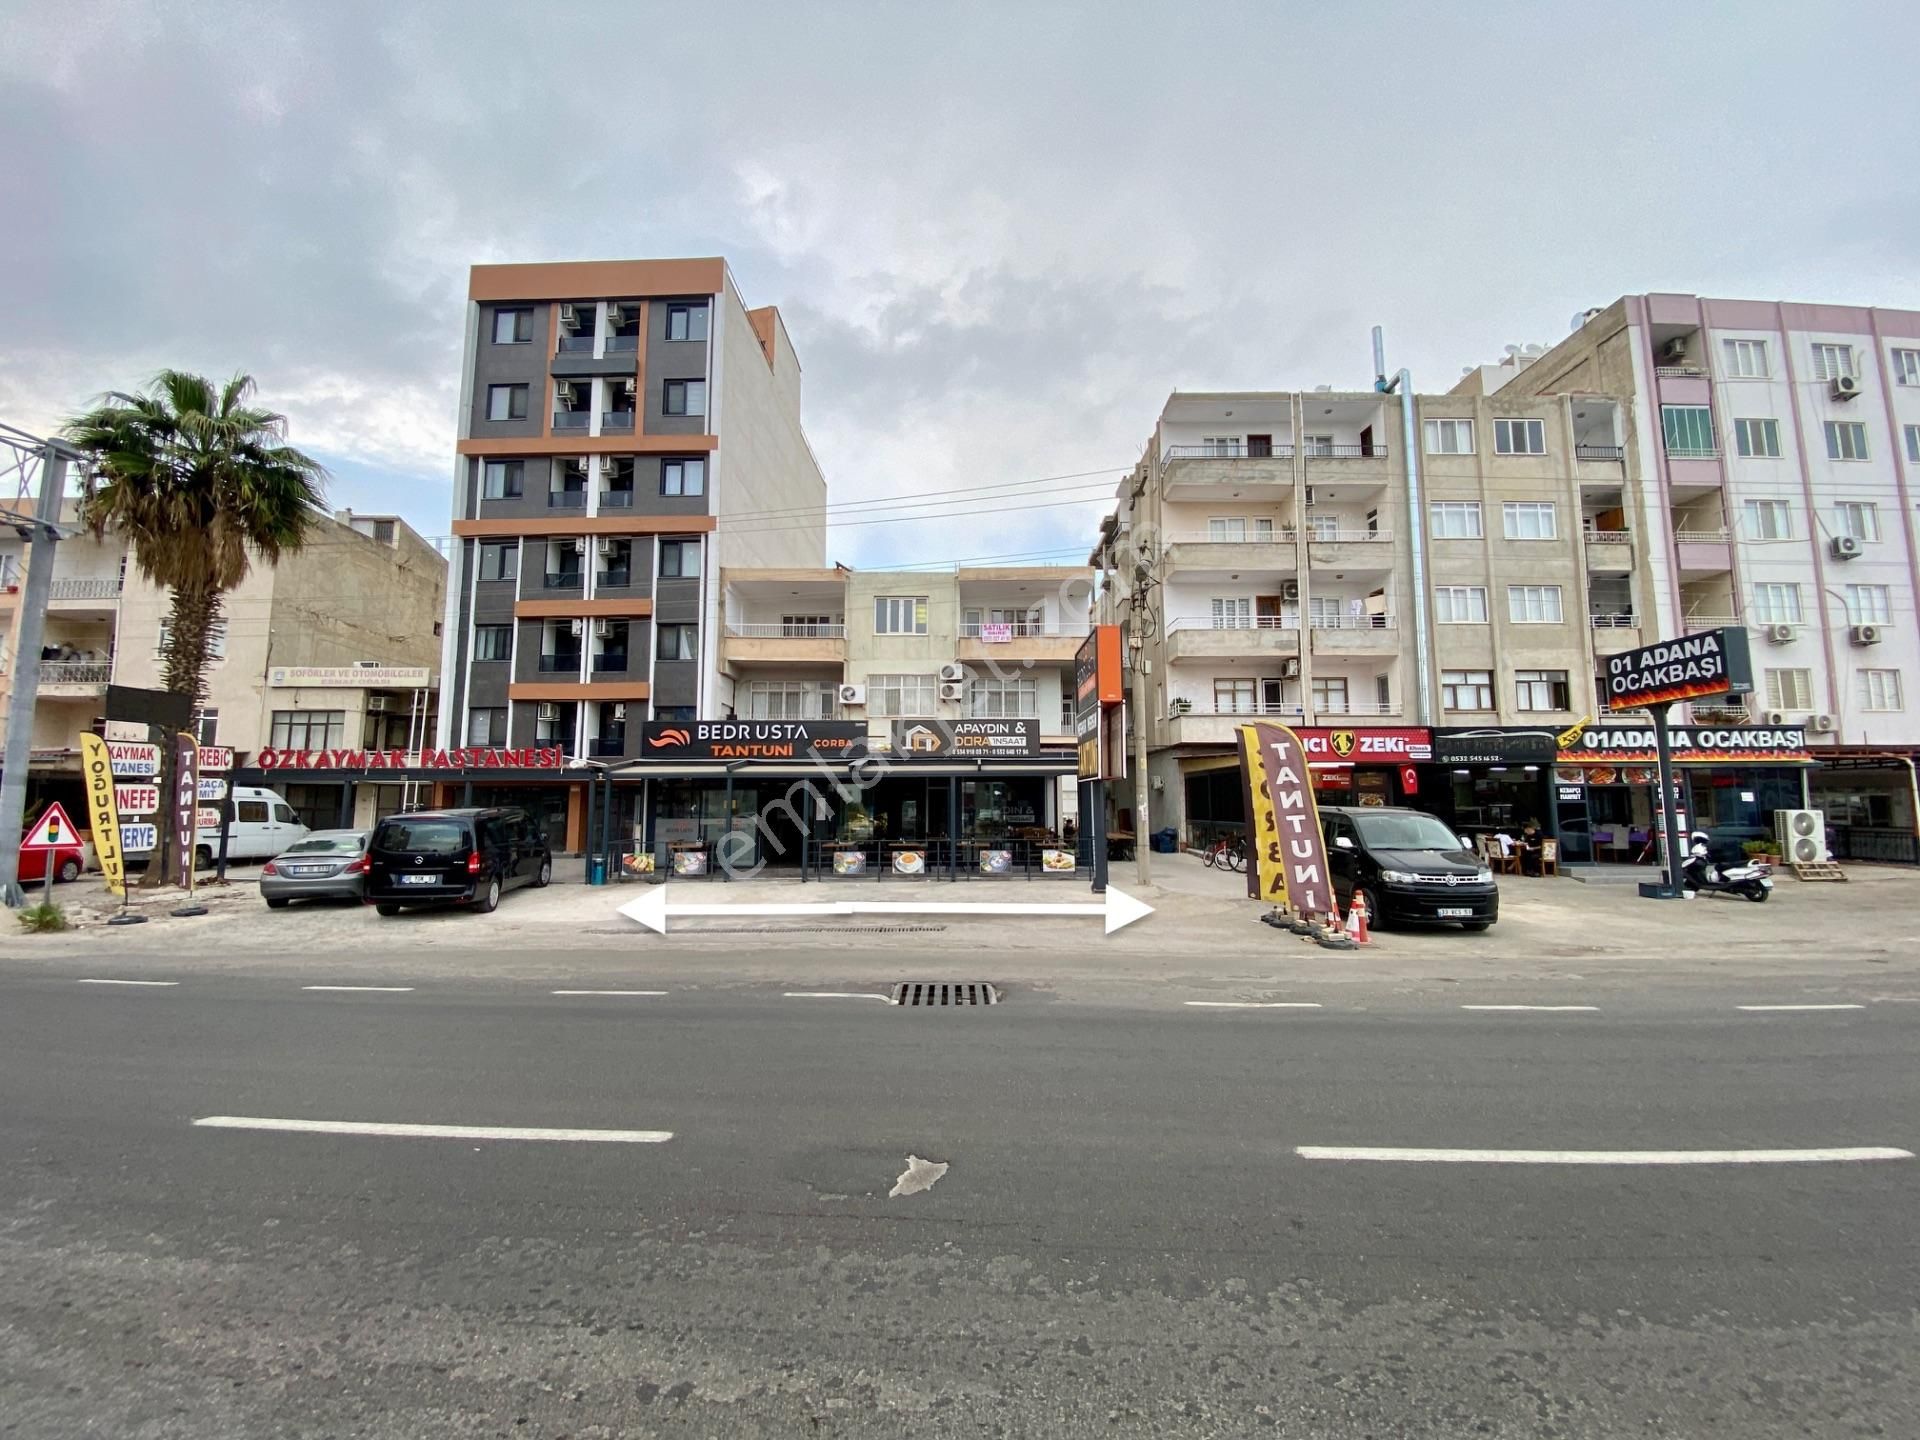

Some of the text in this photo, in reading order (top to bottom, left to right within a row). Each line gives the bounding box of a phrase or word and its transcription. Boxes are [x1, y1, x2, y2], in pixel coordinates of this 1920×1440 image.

[1610, 635, 1719, 674] 01 ADANA
[1612, 655, 1722, 693] OCAKBAŞI
[698, 724, 808, 740] BEDR USTA
[955, 721, 1026, 733] APAYDIN &
[955, 736, 990, 746] DORA
[1697, 731, 1804, 749] OCAKBAŞI
[258, 744, 563, 769] ÖZKAYMAK PASTANESİ
[711, 743, 793, 757] TANTUNİ
